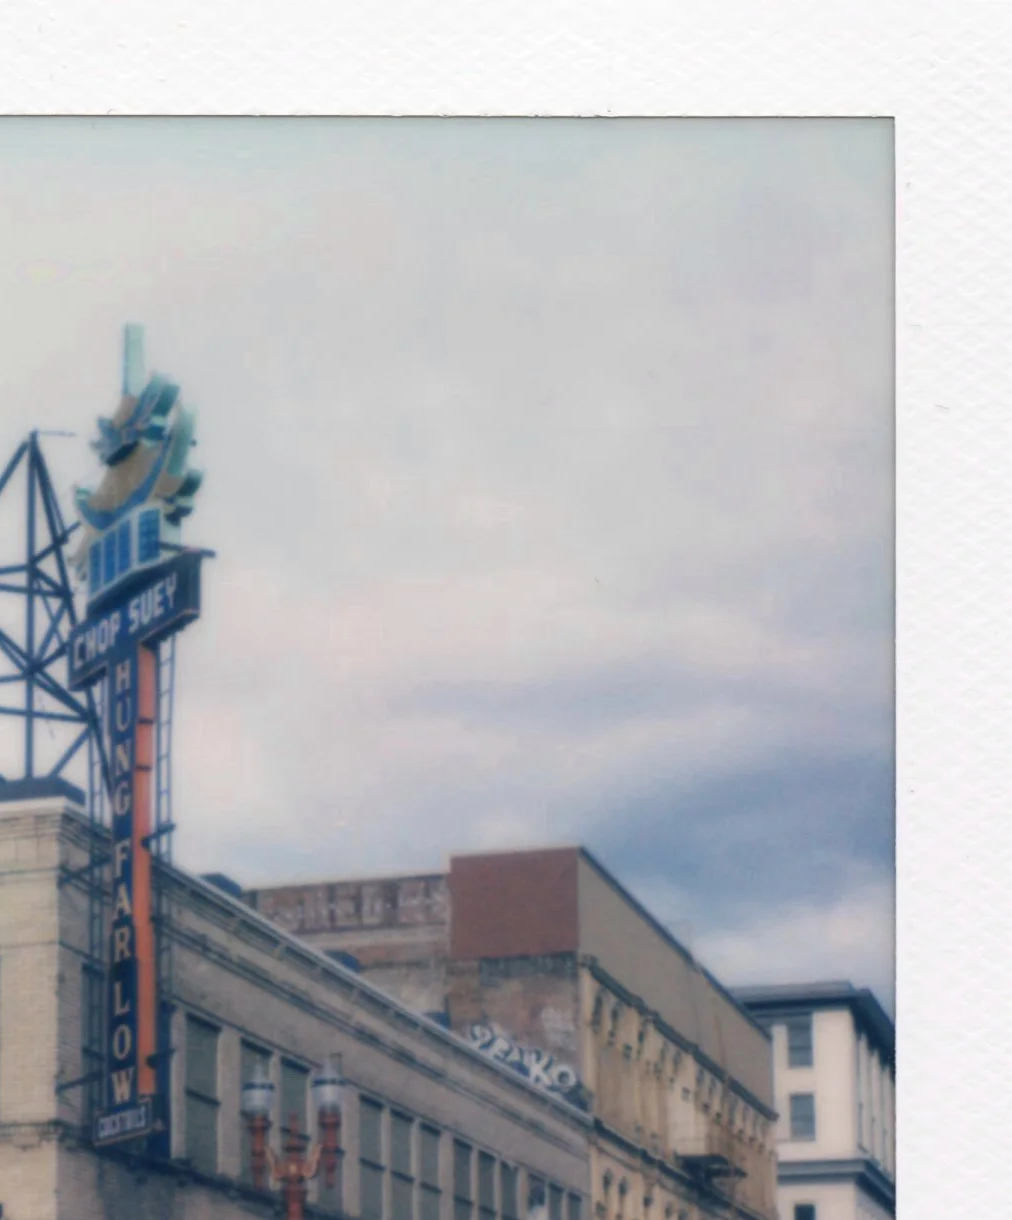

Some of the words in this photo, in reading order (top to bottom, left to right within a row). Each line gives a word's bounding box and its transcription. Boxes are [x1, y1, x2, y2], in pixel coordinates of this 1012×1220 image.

[74, 611, 121, 670] CHOP
[128, 572, 177, 635] SUEY
[113, 659, 131, 816] HUNG
[114, 838, 132, 960] FAR
[111, 980, 134, 1104] LOW
